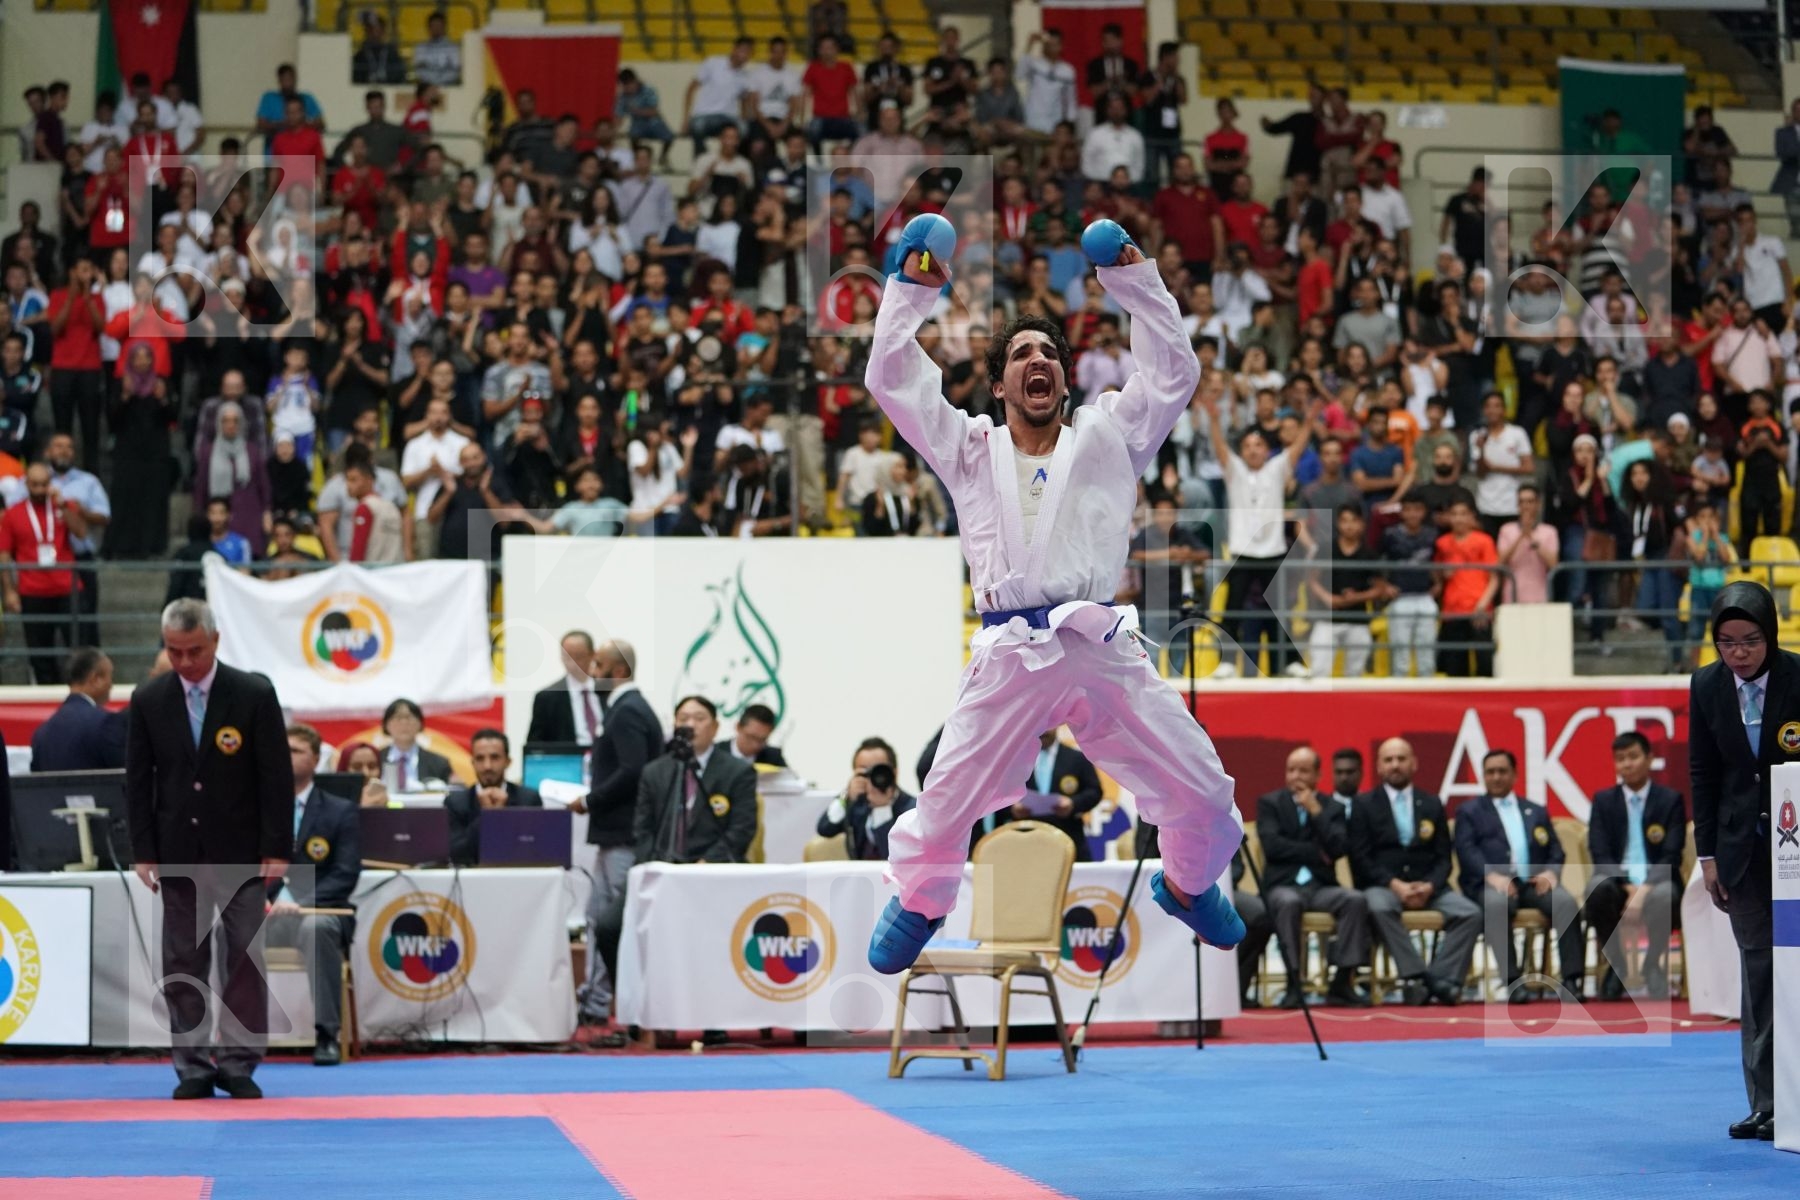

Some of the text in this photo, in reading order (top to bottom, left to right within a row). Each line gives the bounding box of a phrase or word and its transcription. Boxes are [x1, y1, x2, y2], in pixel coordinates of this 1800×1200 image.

[323, 628, 373, 651] WKF
[395, 935, 447, 957] WKF
[757, 935, 811, 957] WKF
[1067, 926, 1116, 948] WKF
[7, 928, 41, 1023] KARATE
